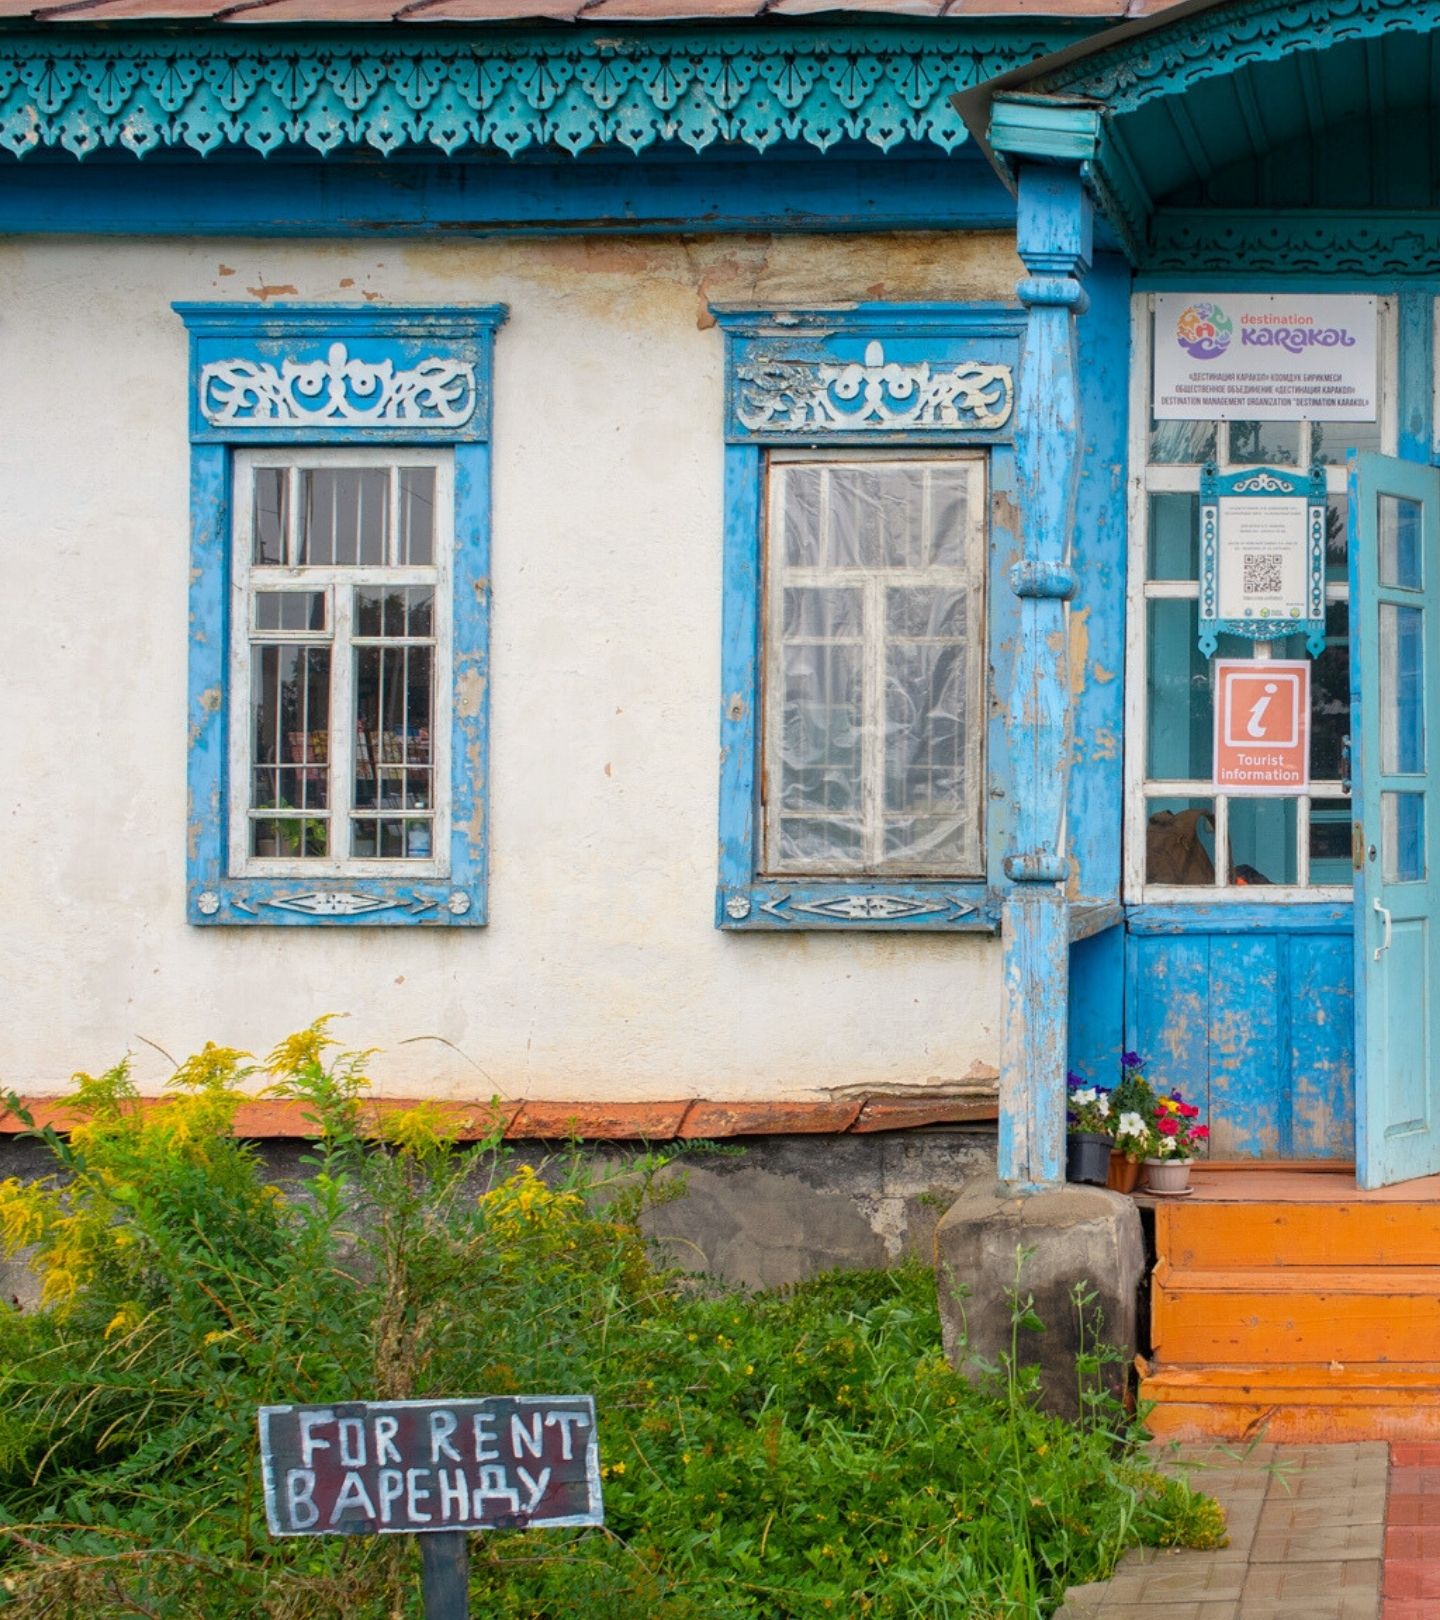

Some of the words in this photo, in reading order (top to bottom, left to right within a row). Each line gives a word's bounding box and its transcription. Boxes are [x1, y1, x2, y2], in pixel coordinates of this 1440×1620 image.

[1241, 312, 1313, 325] destination
[1237, 753, 1285, 766] Tourist
[1221, 768, 1299, 781] information
[298, 1409, 403, 1469] FOR
[428, 1409, 590, 1464] RENT
